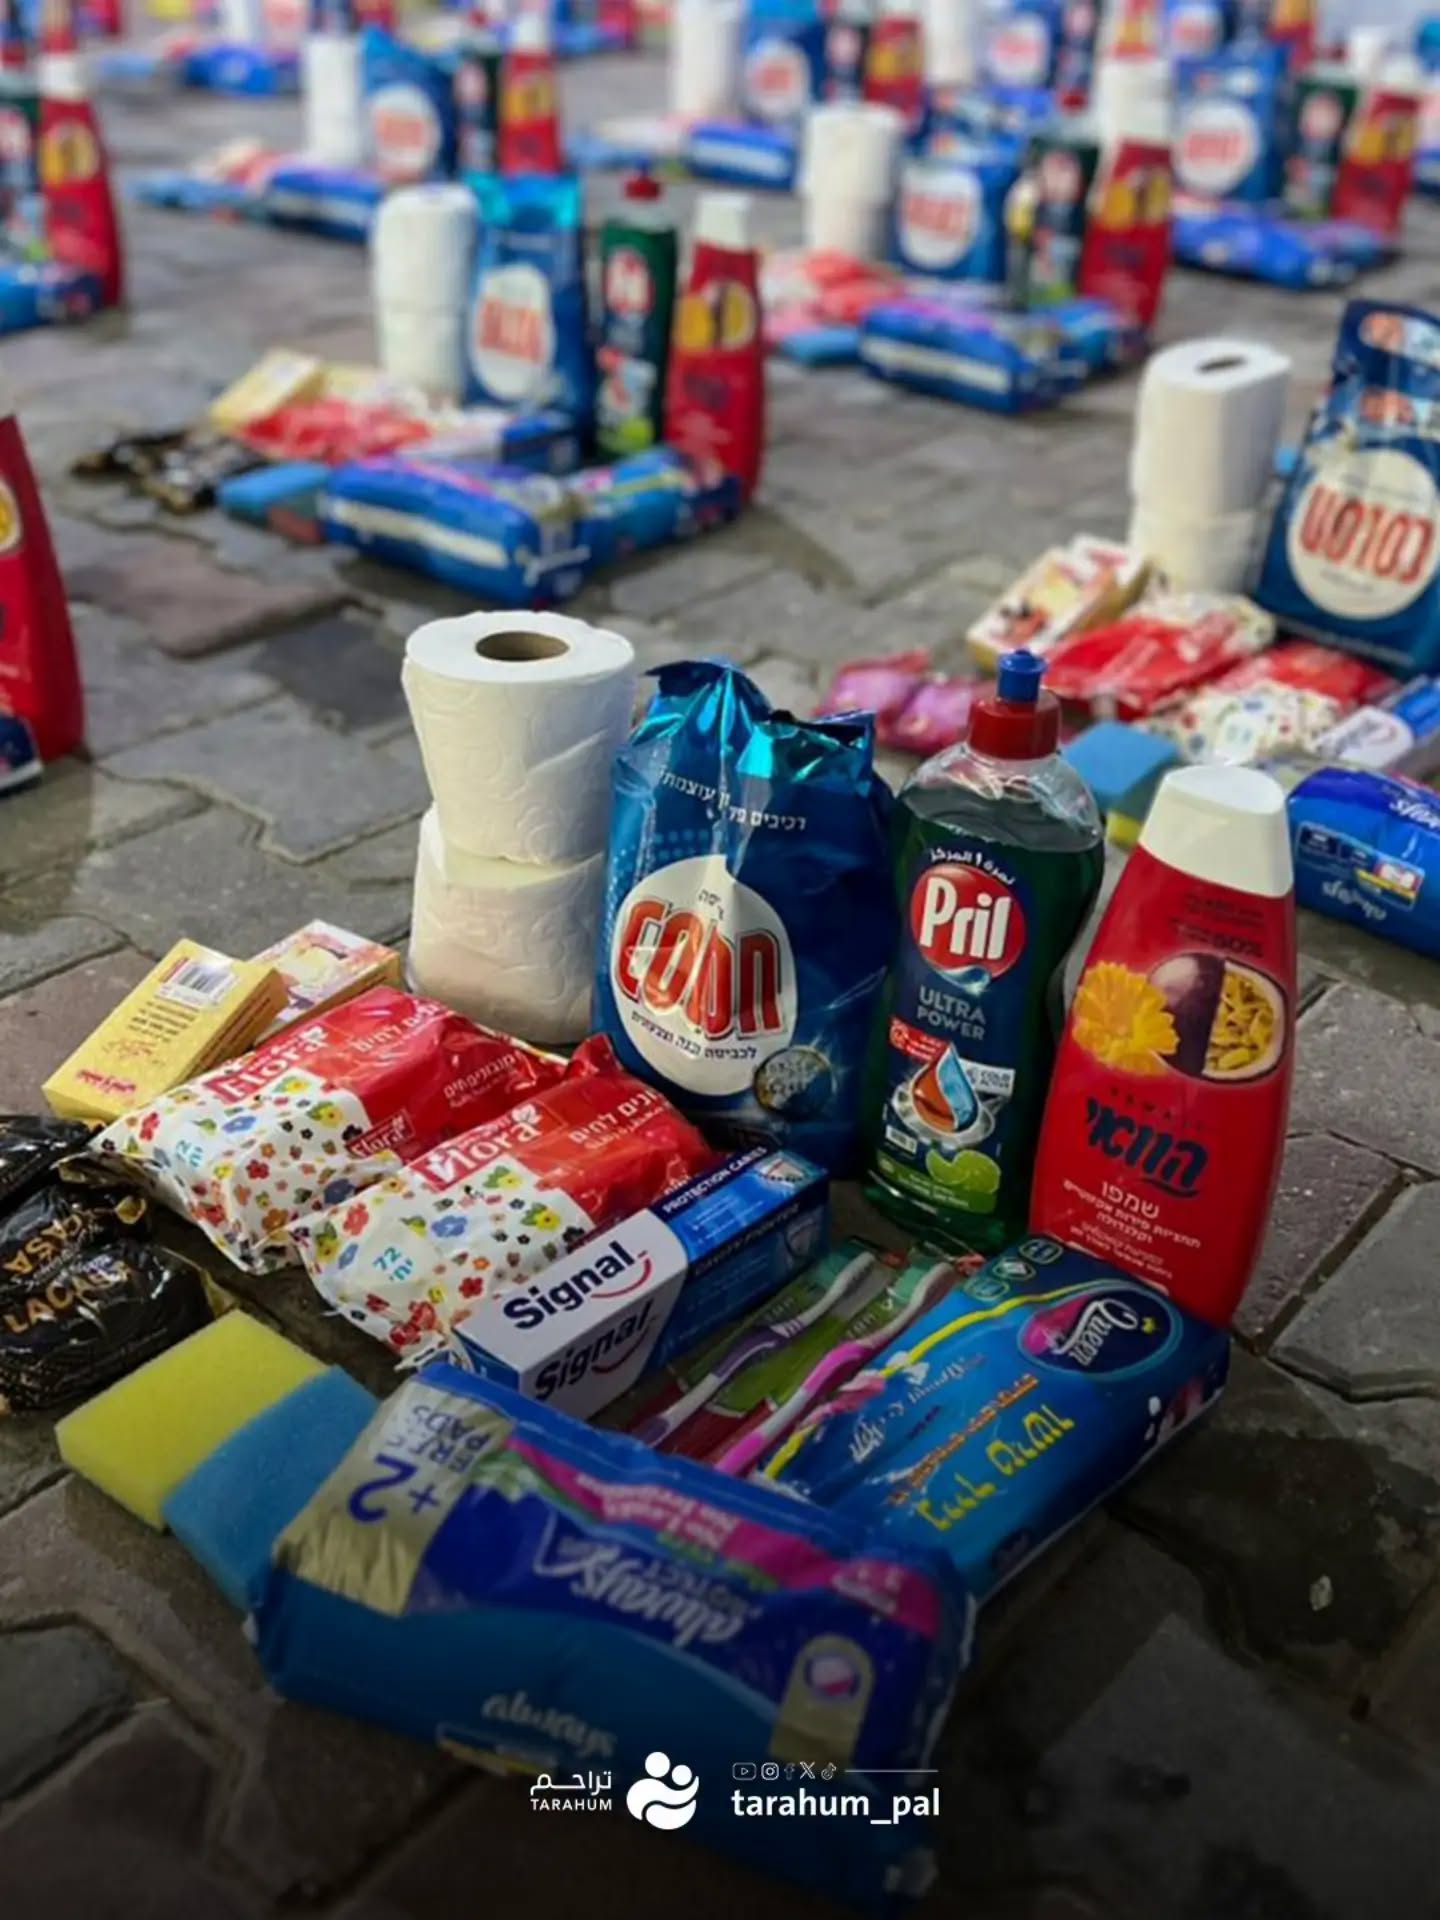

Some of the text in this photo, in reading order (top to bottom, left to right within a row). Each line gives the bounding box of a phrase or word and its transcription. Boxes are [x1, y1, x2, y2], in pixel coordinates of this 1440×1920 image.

[919, 876, 1011, 960] Pril
[917, 1003, 986, 1041] POWER
[920, 985, 986, 1025] ULTRA
[217, 1036, 330, 1100] Flora
[675, 1036, 701, 1057] בנה
[704, 1046, 758, 1059] לכביסה
[353, 1124, 405, 1158] Flora
[569, 1113, 617, 1144] לחים
[1086, 1097, 1209, 1189] הוואי
[662, 1169, 731, 1215] PROTECTION
[1102, 1180, 1160, 1219] שמפו
[372, 1245, 402, 1271] 72
[503, 1240, 635, 1331] Signal
[535, 1298, 654, 1403] Signal
[1058, 1298, 1139, 1368] Queen
[412, 1405, 492, 1450] PADS
[986, 1403, 1075, 1476] טישו
[571, 1539, 749, 1650] always
